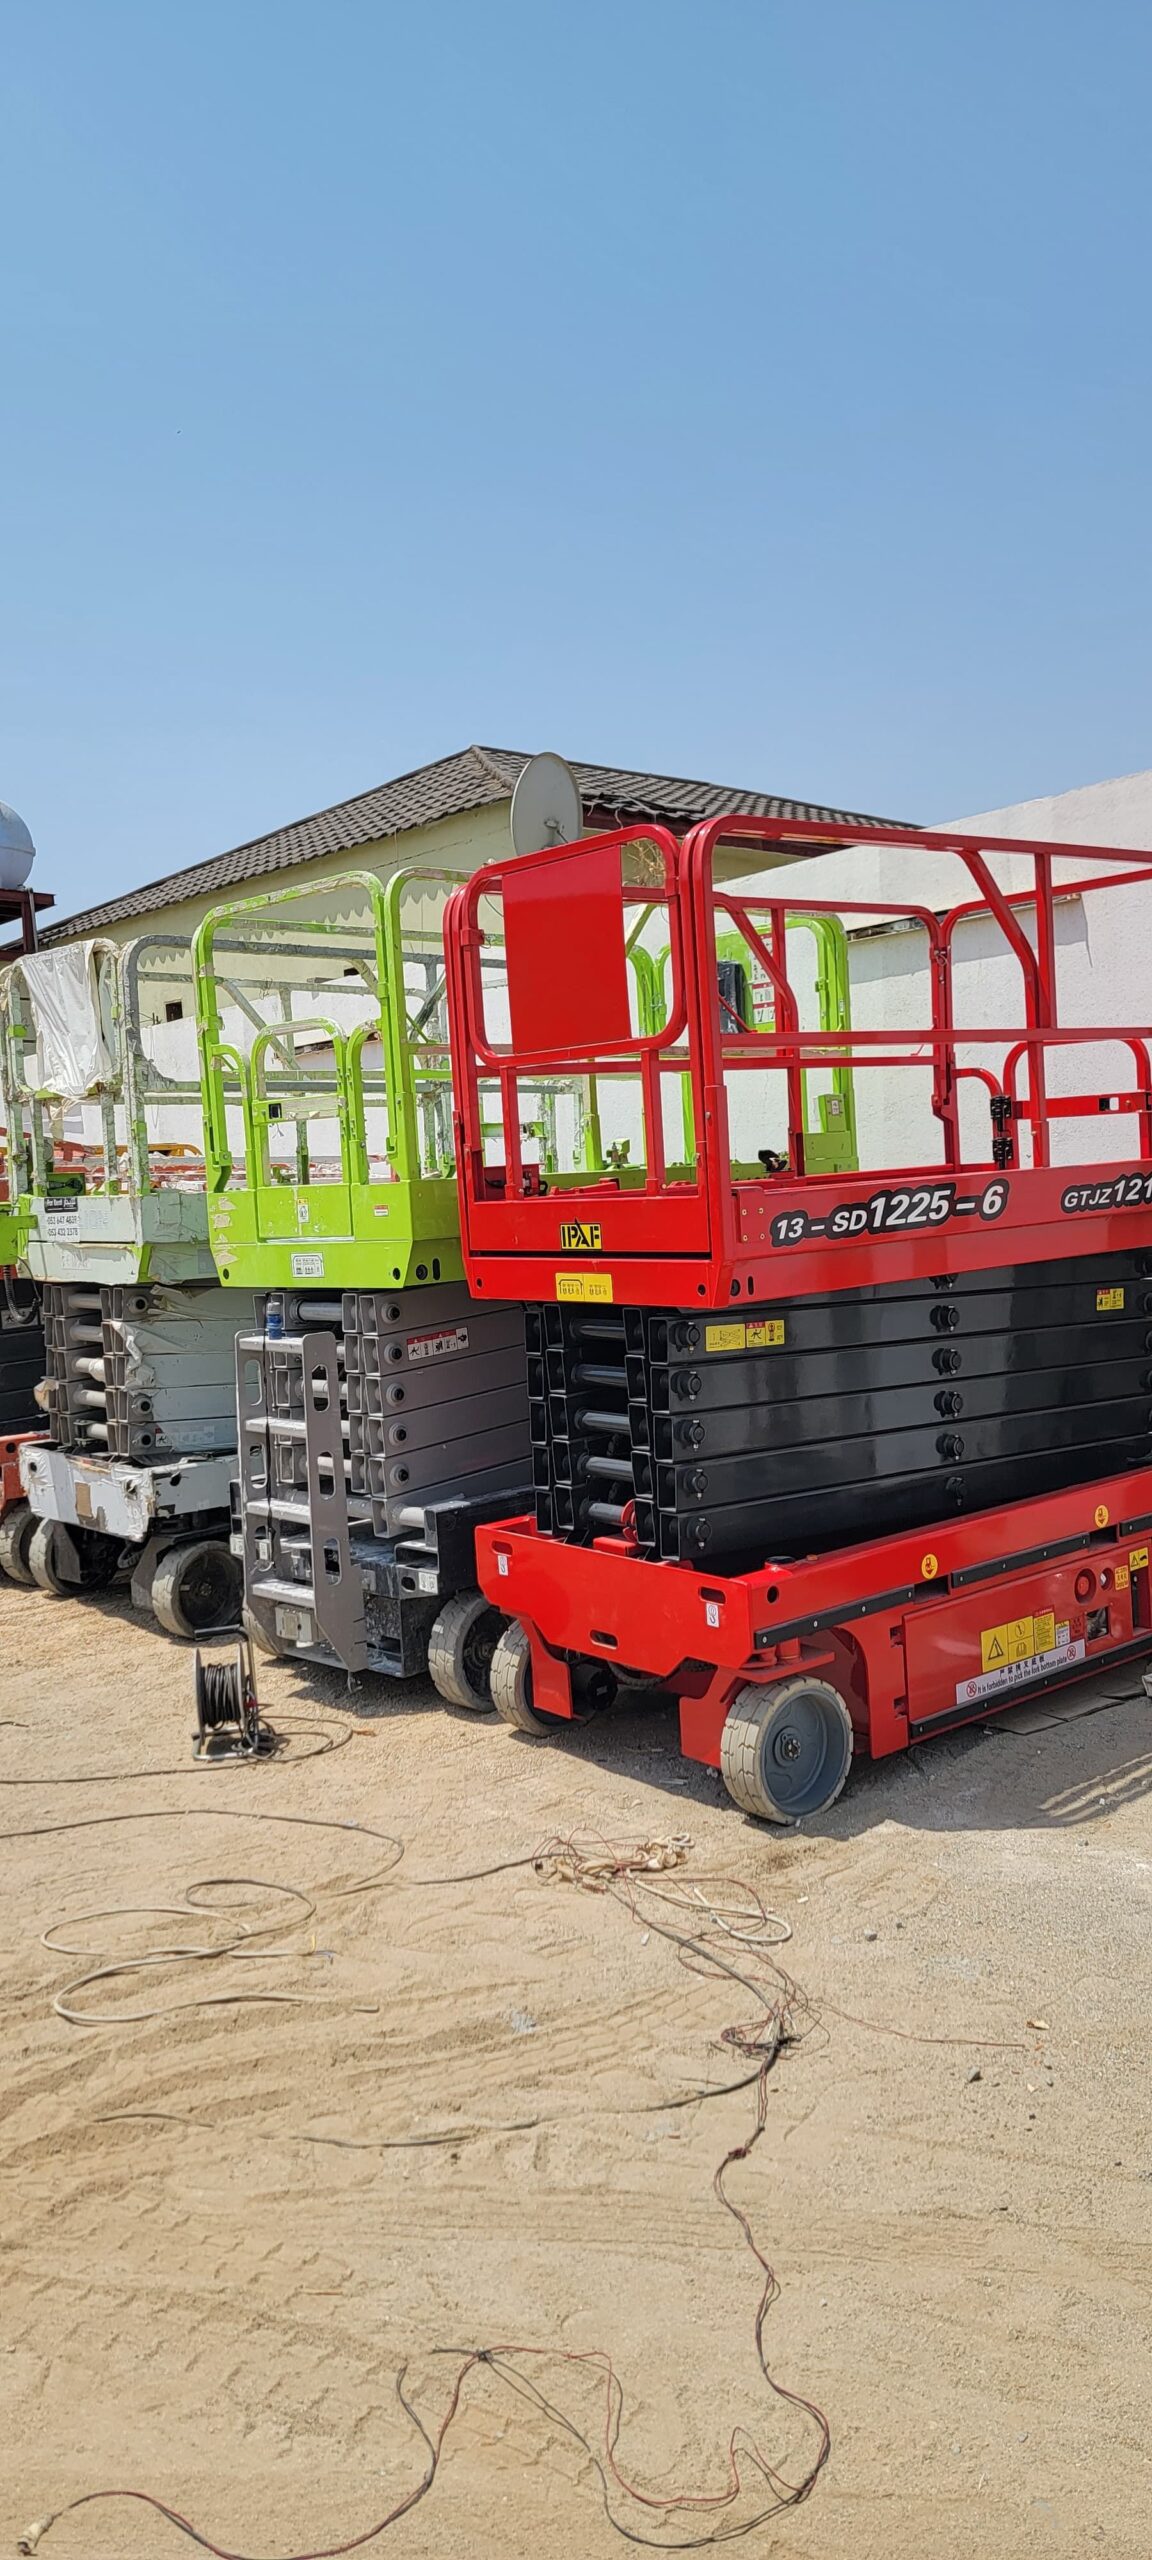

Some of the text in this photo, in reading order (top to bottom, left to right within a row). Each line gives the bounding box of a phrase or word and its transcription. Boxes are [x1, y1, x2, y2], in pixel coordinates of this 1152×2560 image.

[561, 1217, 600, 1248] IPAF
[987, 1677, 1007, 1691] forbidden
[1040, 1660, 1057, 1672] bottom
[1056, 1656, 1068, 1666] plate
